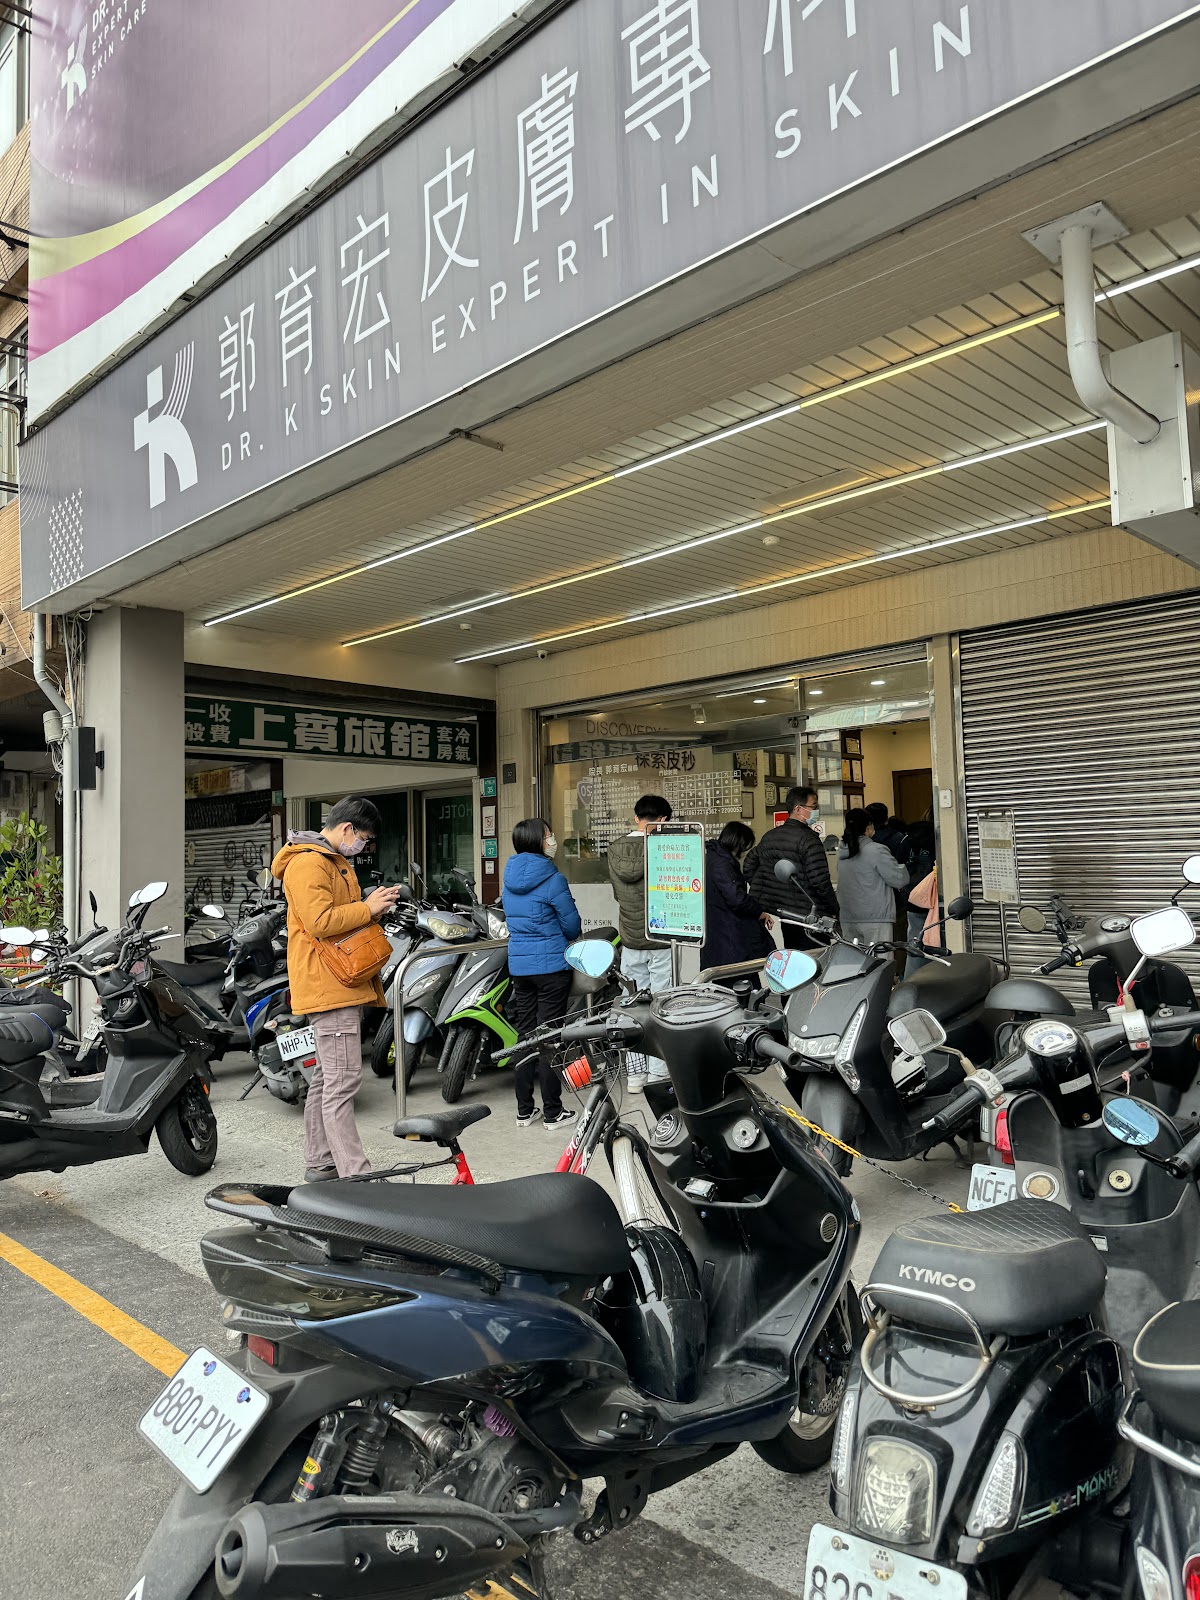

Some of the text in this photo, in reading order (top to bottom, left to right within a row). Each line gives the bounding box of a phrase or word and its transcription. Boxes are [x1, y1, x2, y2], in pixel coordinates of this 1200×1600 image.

[91, 0, 147, 80] SKIN CARE
[92, 0, 129, 56] EXPERT
[221, 4, 971, 471] DR. K SKIN EXPERT IN SKIN
[898, 1264, 976, 1292] KYMCO
